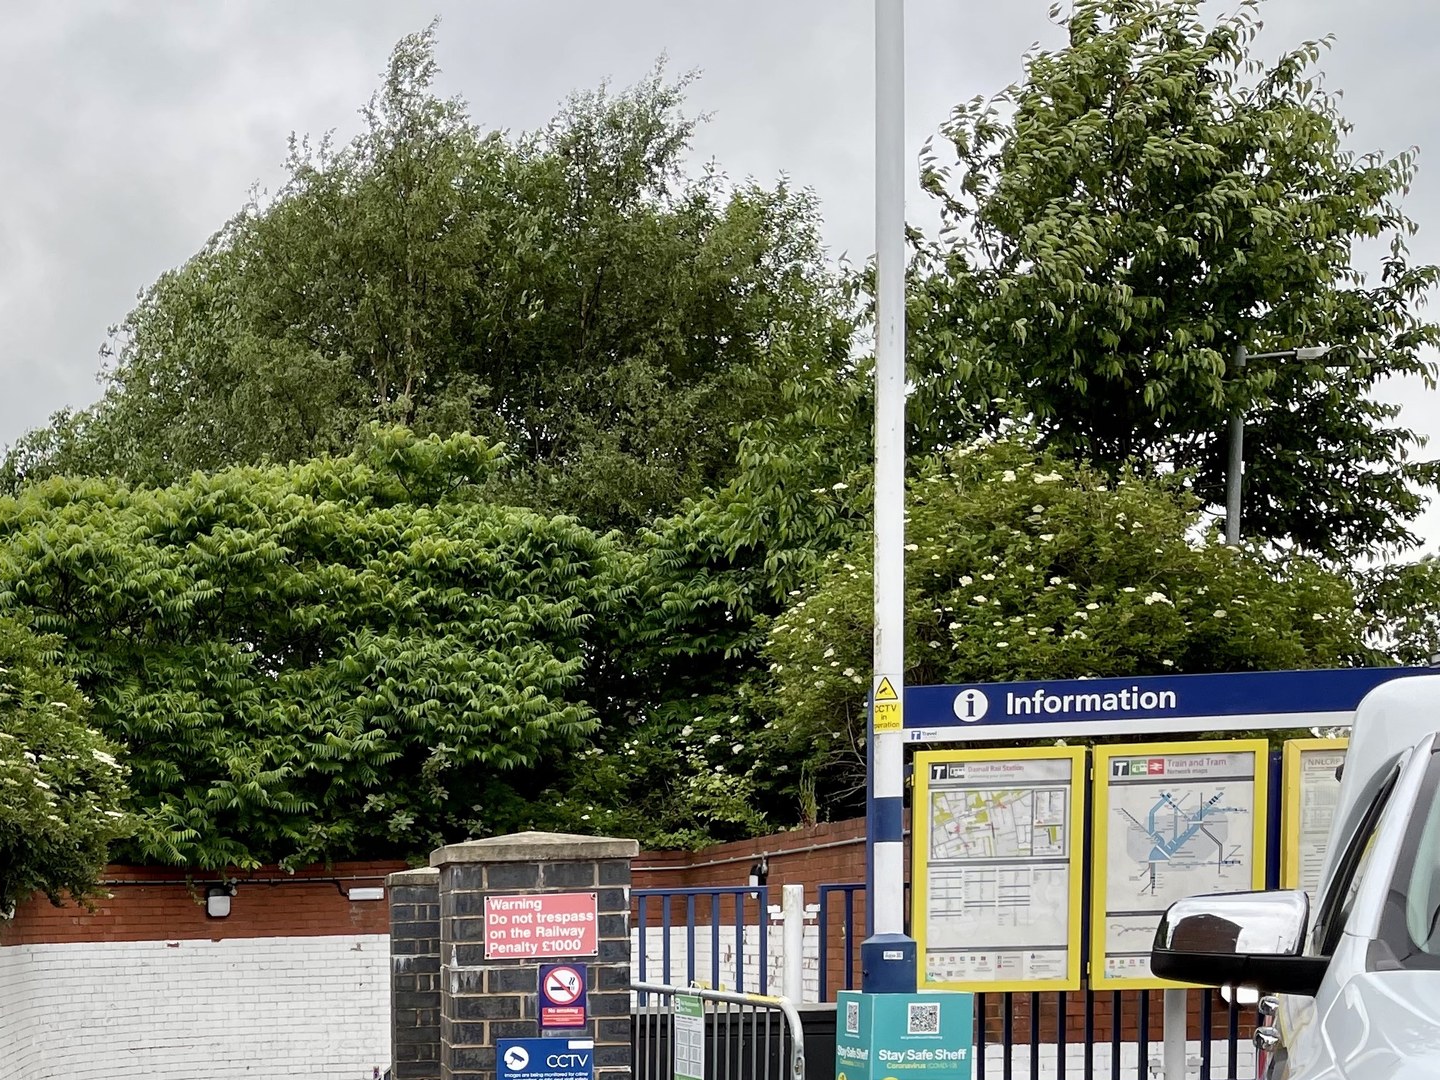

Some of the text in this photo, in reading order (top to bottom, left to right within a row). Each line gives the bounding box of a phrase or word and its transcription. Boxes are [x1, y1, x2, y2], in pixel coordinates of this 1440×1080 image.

[1006, 686, 1176, 715] Information
[875, 704, 897, 713] CCTV
[1167, 758, 1190, 768] Train
[1191, 758, 1204, 767] and
[1205, 757, 1227, 766] Tram
[490, 898, 543, 911] Warning
[489, 912, 594, 925] Do not trespass
[490, 925, 585, 939] on the Railway
[490, 939, 581, 955] Penalty £1000
[546, 1054, 588, 1068] CCTV
[878, 1049, 905, 1063] Stay
[906, 1049, 933, 1061] Safe
[934, 1048, 967, 1061] Sheff
